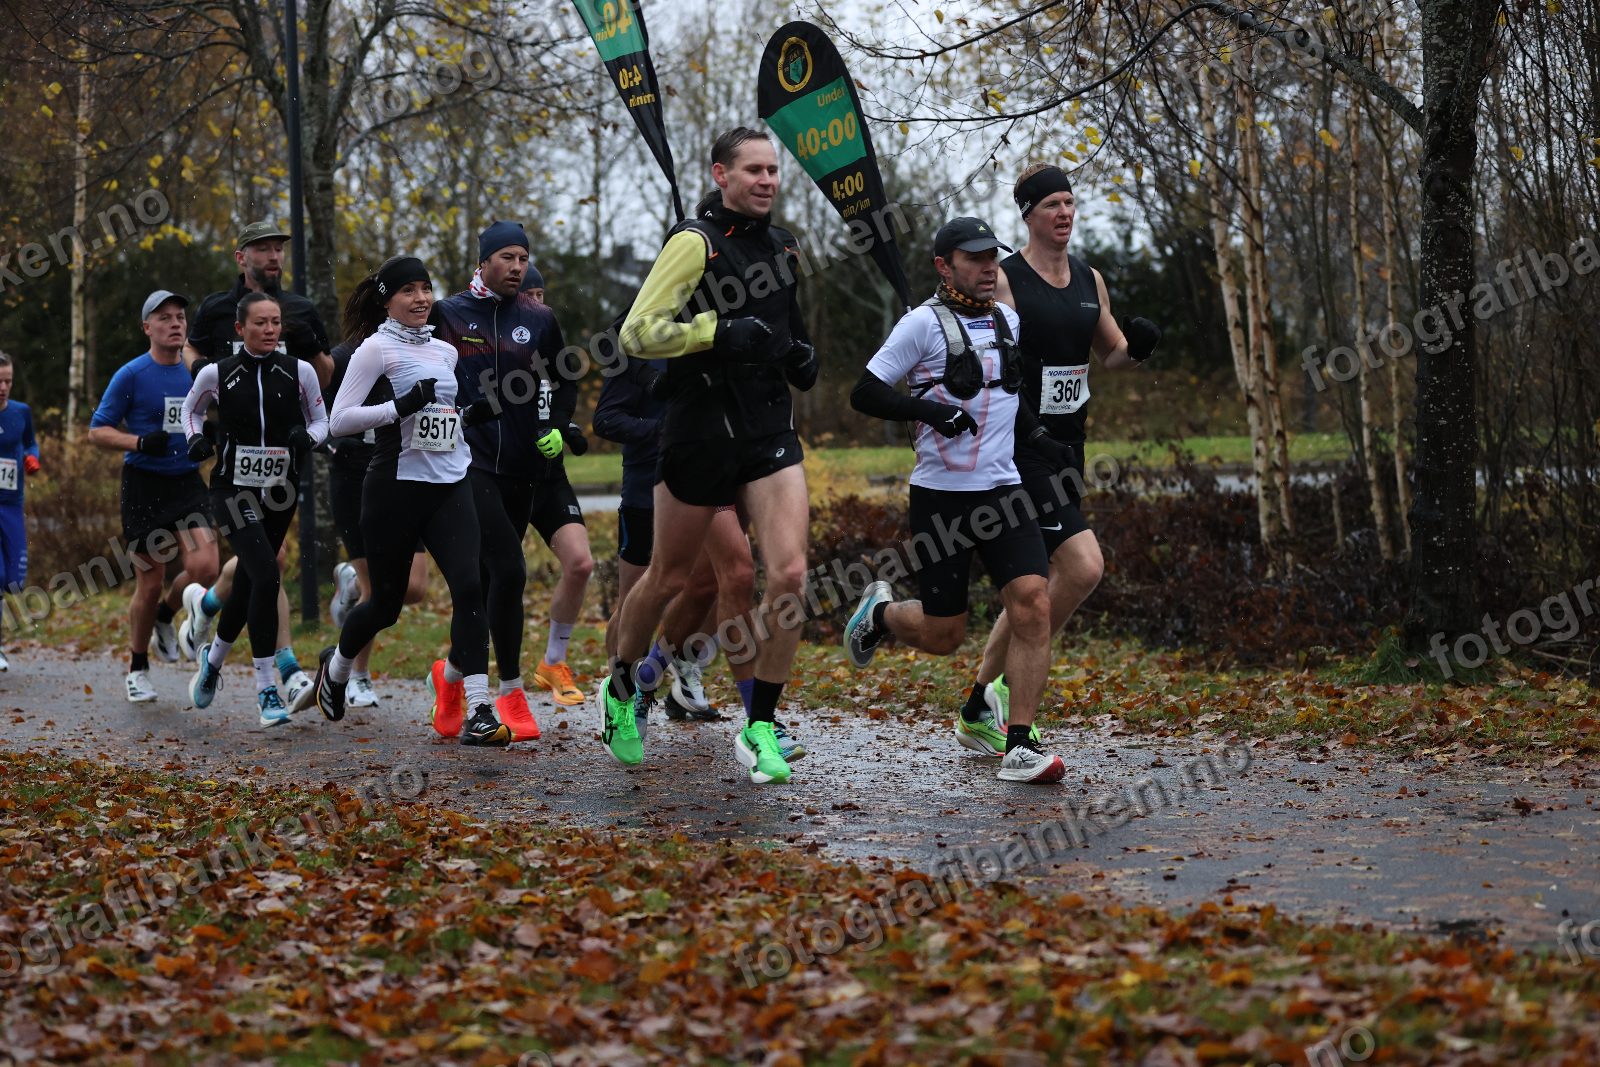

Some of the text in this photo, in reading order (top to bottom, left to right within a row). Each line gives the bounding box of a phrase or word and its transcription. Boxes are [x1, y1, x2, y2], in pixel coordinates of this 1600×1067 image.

[817, 87, 844, 107] Under
[797, 112, 856, 160] 40:00
[833, 171, 864, 201] 4:00
[843, 198, 870, 218] min/km
[1053, 379, 1081, 403] 360
[419, 416, 456, 439] 9517
[240, 457, 285, 477] 9495
